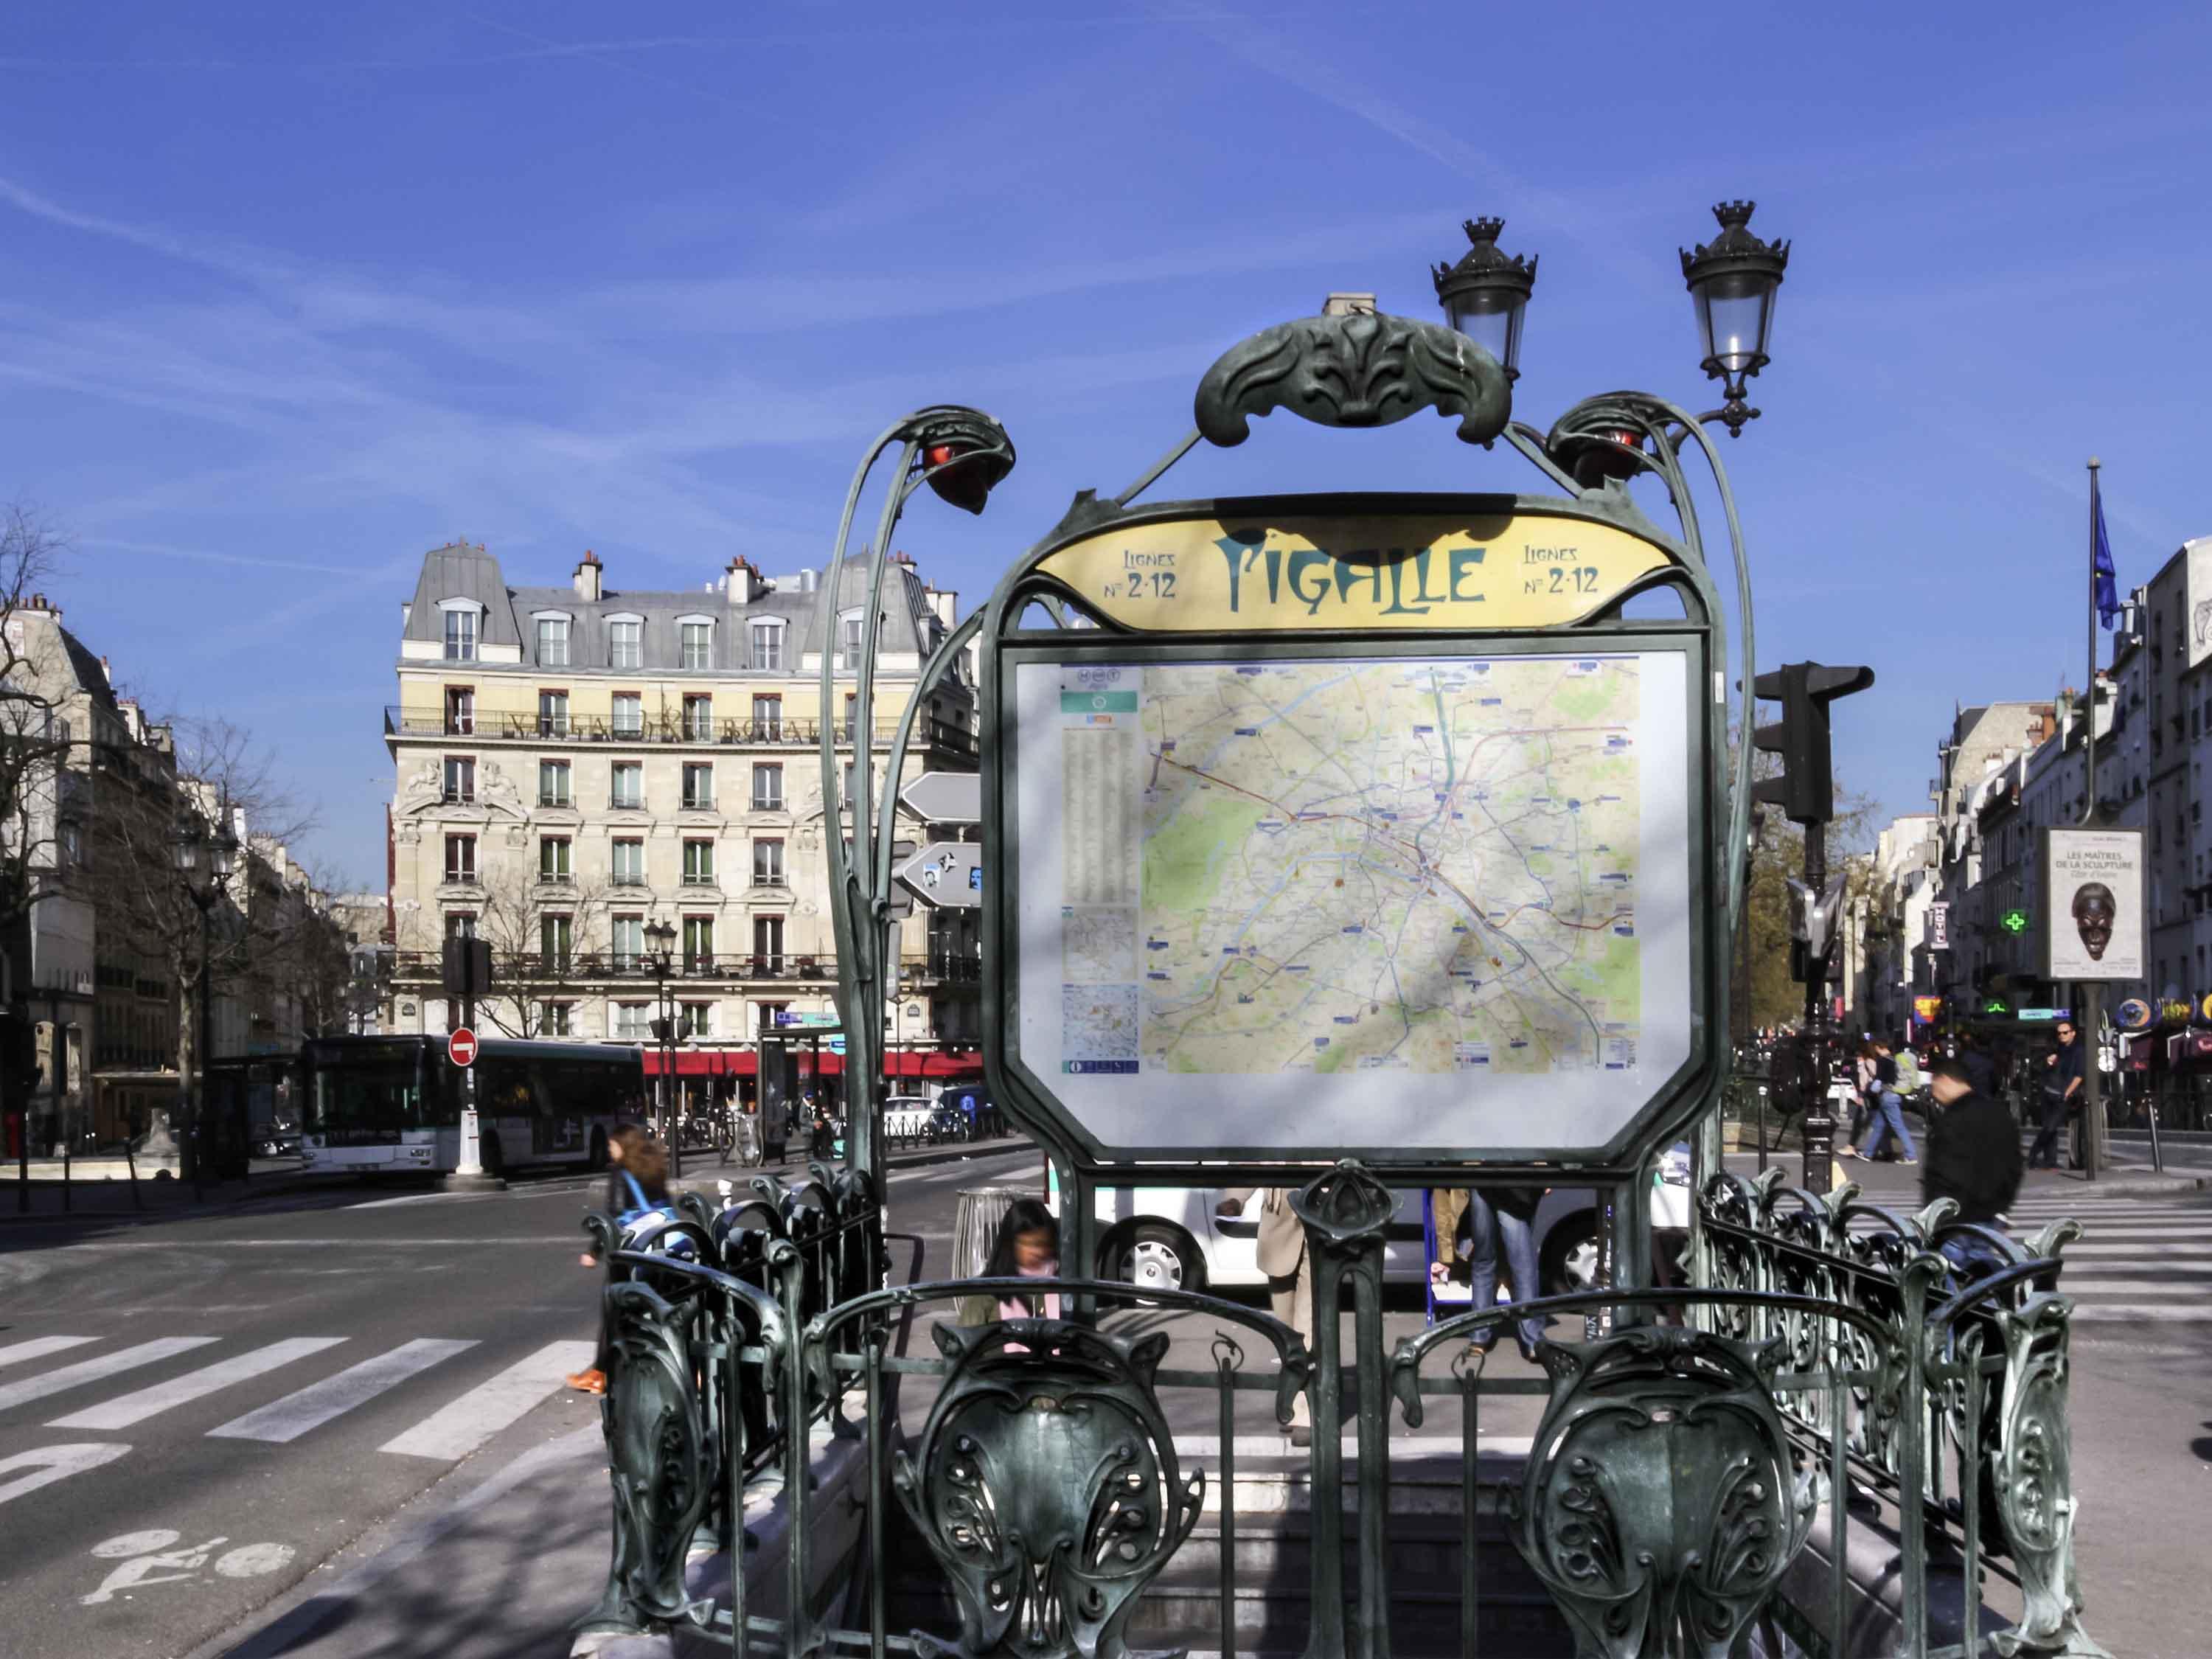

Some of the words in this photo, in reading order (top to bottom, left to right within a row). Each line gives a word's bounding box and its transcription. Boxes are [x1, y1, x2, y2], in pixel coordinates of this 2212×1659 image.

[1212, 528, 1486, 615] PIGALLE
[2066, 852, 2081, 860] LES
[2084, 849, 2122, 860] MAÎTRES
[2082, 861, 2133, 869] SCULPTURE
